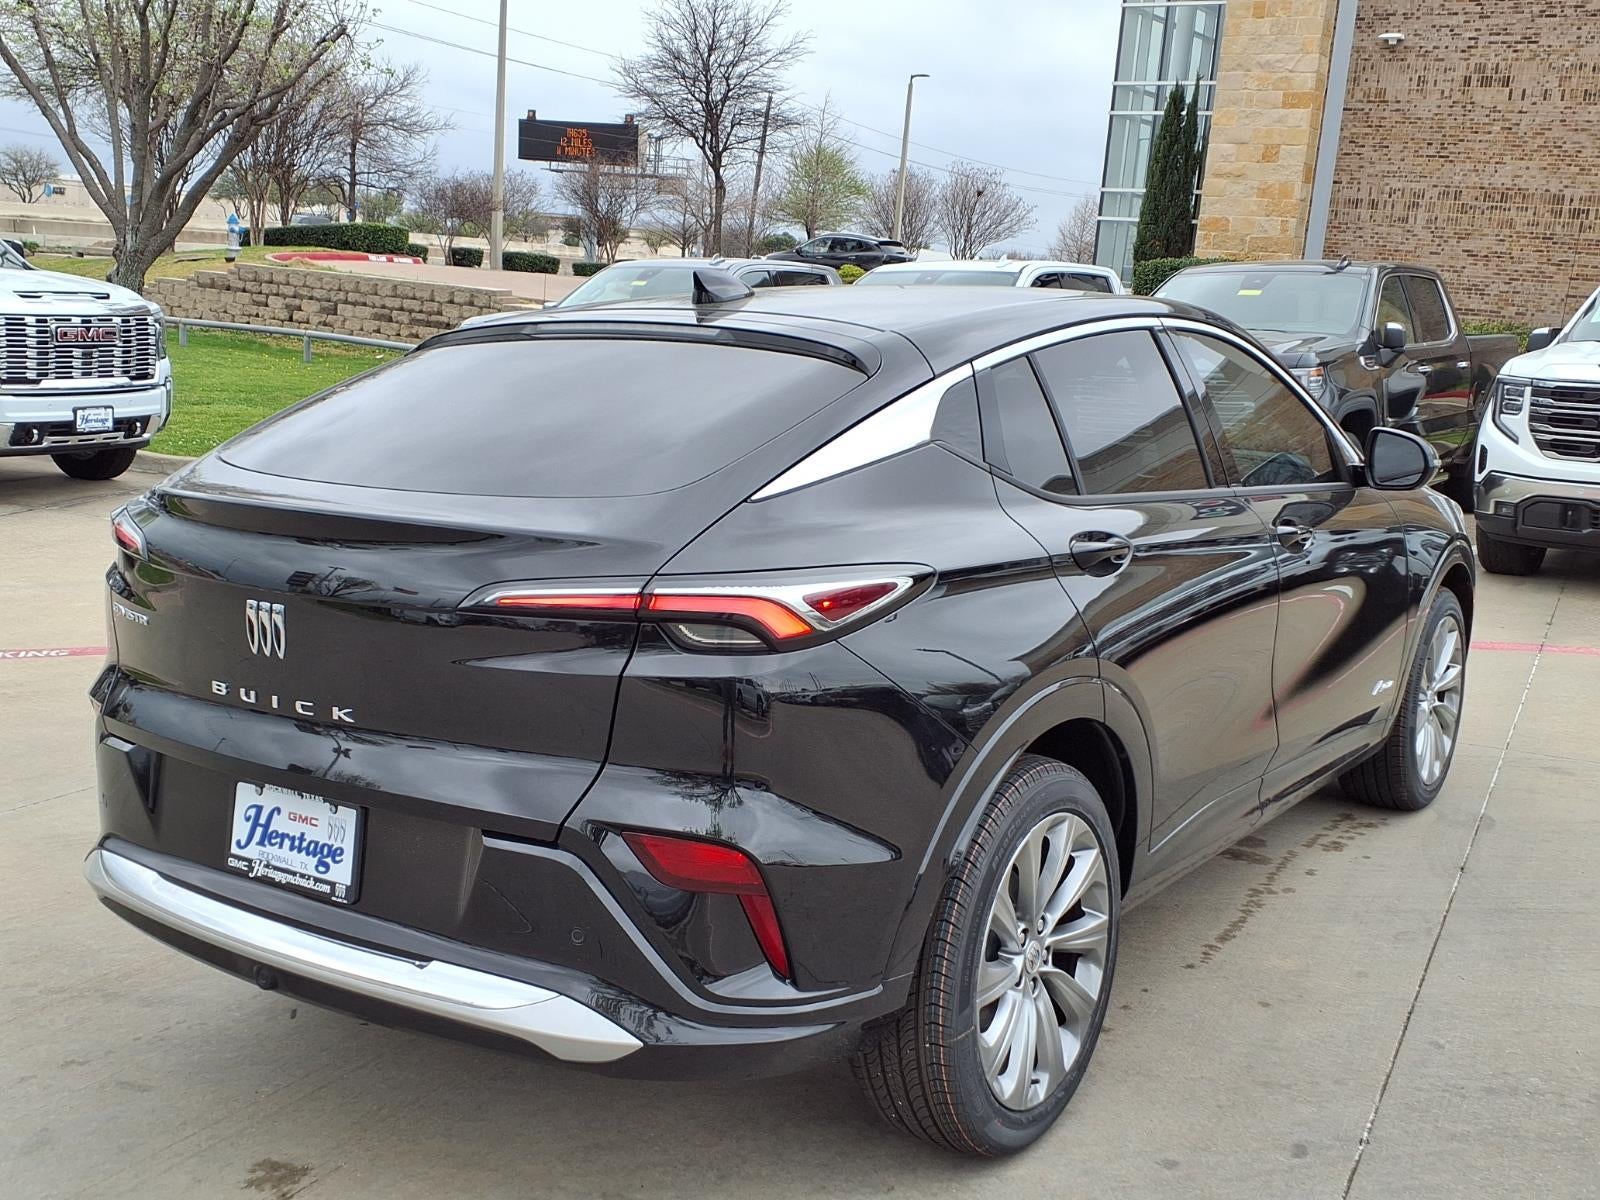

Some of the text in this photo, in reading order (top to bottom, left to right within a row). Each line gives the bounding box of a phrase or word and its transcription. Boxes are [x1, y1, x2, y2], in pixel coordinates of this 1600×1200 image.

[57, 328, 118, 342] GMC
[211, 680, 355, 723] BUICK
[288, 811, 320, 828] GMC
[235, 803, 345, 875] Heritage
[228, 857, 249, 871] GMC
